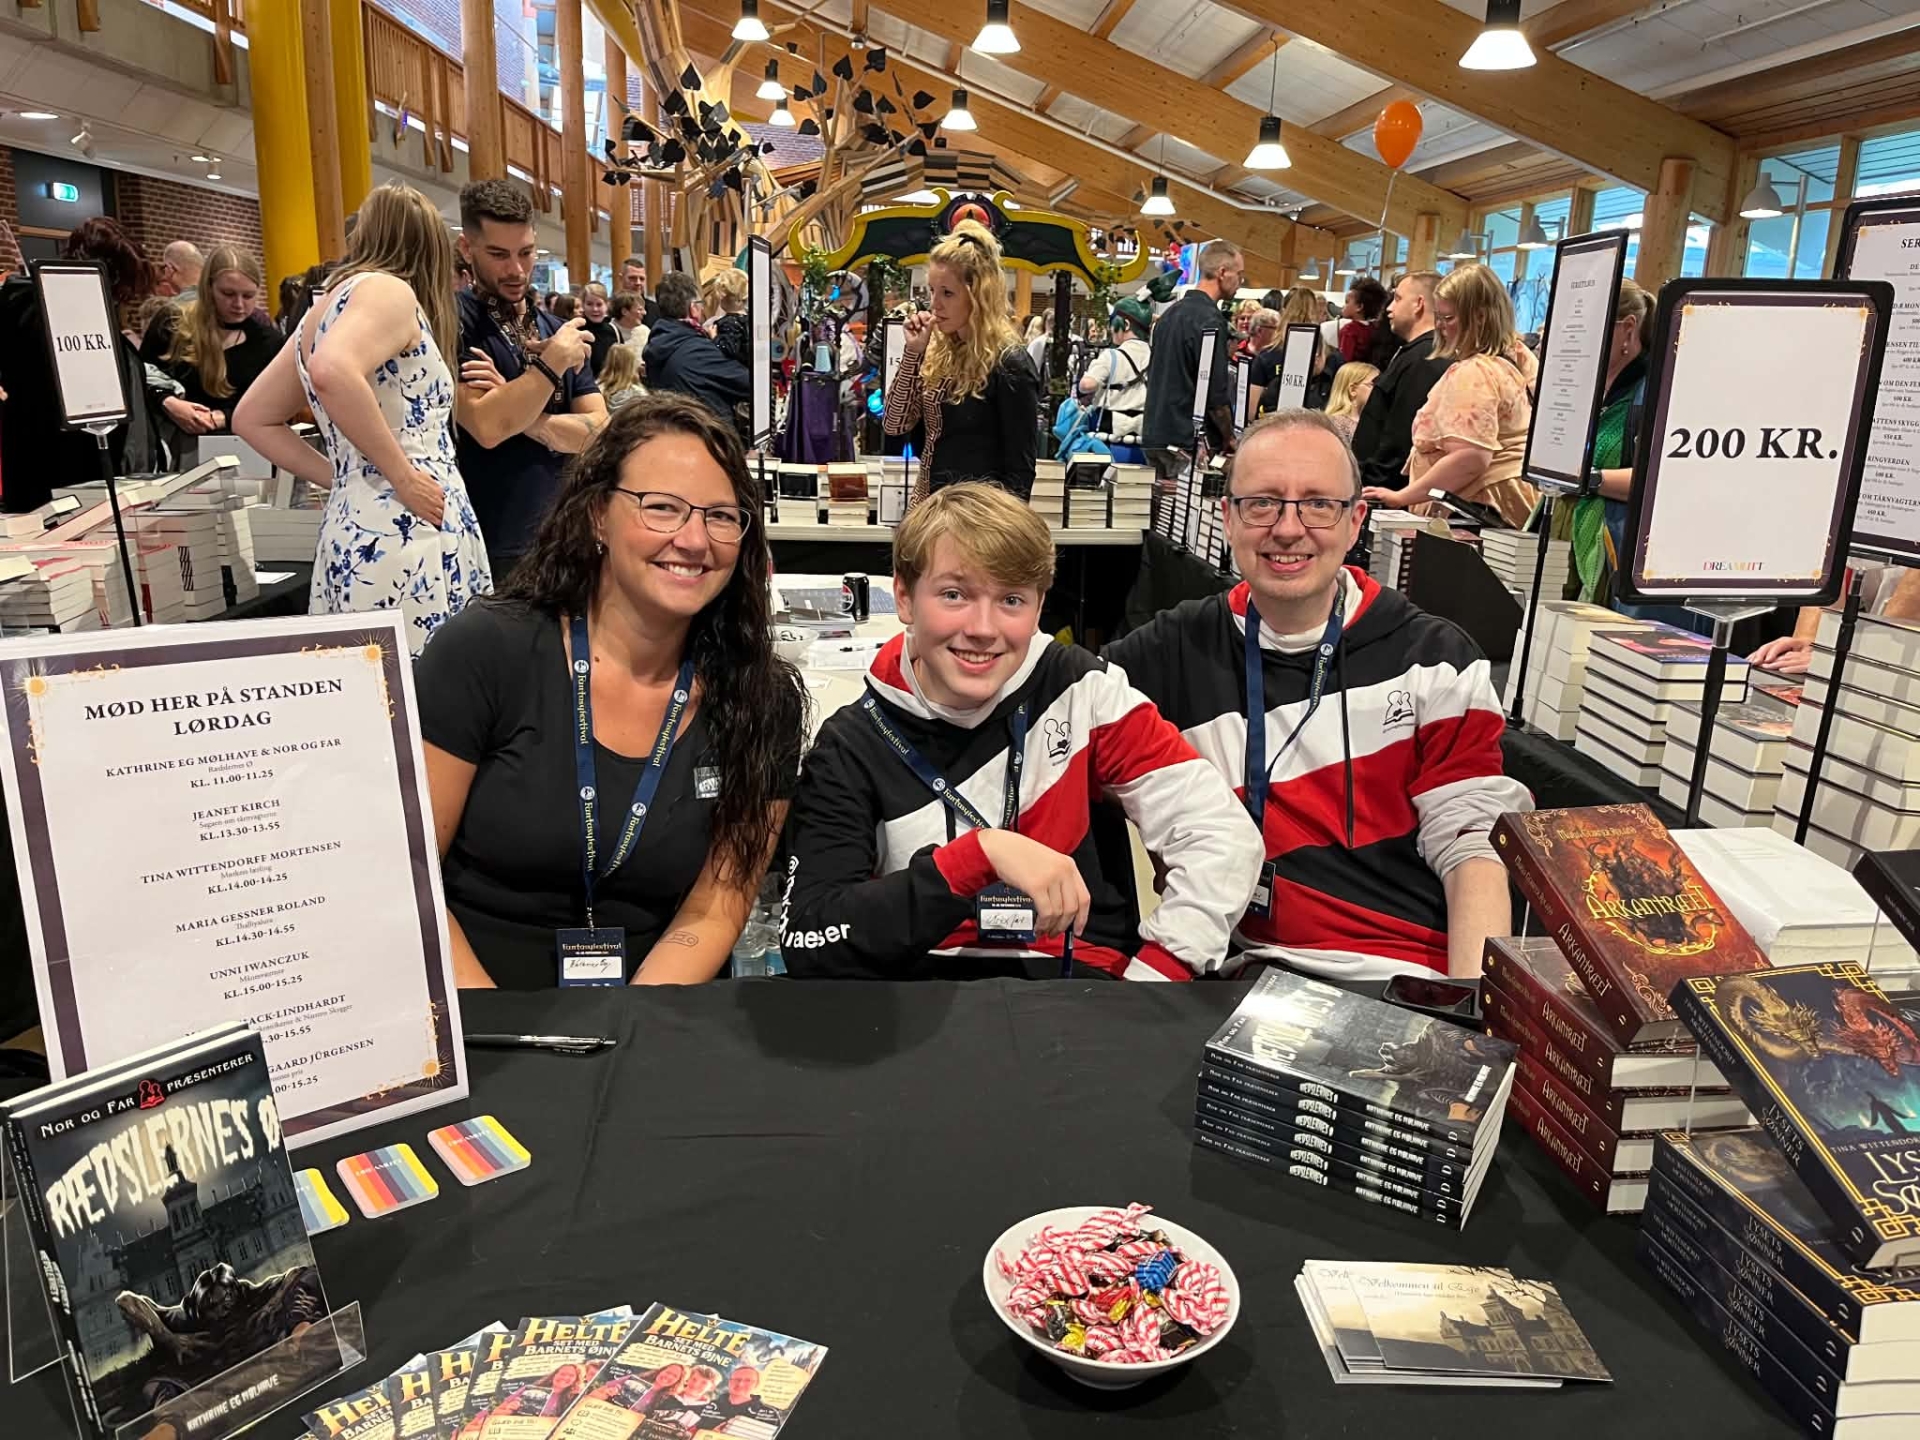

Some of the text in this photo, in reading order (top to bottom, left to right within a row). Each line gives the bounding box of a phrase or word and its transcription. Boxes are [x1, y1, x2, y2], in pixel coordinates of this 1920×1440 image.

[1901, 238, 1920, 248] SER
[56, 333, 112, 354] 100 KR.
[890, 357, 900, 366] 15
[1294, 374, 1305, 388] KR.
[1667, 428, 1838, 460] 200 KR.
[1874, 494, 1920, 507] TÅRNVAGTERN
[85, 679, 343, 720] MØD HER PÅ STANDEN
[174, 711, 272, 736] LØRDAG
[106, 738, 342, 777] KATHRINE EG MØLHAVE & NOR OG FAR
[190, 770, 274, 788] KL. 11.00-11.25
[192, 799, 280, 821] JEANET KIRCH
[943, 788, 986, 828] Fantasyfesti
[200, 821, 280, 842] KL.13.30-13.55
[611, 815, 640, 873] Fantasyfestiv
[141, 840, 342, 884] TINA WITTENDORFF MORTENSEN
[208, 872, 288, 895] KL.14.00-14.25
[980, 895, 1032, 903] Fantasyfestiva
[1585, 885, 1713, 920] ARKANTRÆET
[176, 918, 218, 932] MARIA
[220, 906, 274, 924] GESSNER
[277, 896, 326, 912] ROLAND
[216, 924, 296, 948] KL.14.30-14.55
[210, 951, 310, 980] UNNI IWANCZUK
[1558, 922, 1612, 998] ARKANTRÆET
[224, 974, 303, 1000] KL.15.00-15.25
[247, 995, 346, 1025] ACK-LINDHARDT
[263, 1024, 312, 1044] .30-15.55
[268, 1038, 374, 1074] GAARD JÜRGENSEN
[40, 1119, 74, 1139] NOR
[80, 1110, 100, 1123] OG
[107, 1097, 136, 1116] FAR
[166, 1053, 254, 1093] PRÆSENTERER
[275, 1076, 318, 1095] 00-15.25
[1769, 1104, 1805, 1152] LYSETS
[45, 1095, 281, 1238] RÆDSLERNES Ø
[1864, 1151, 1920, 1184] LYS
[518, 1318, 630, 1346] HELTE
[643, 1307, 751, 1358] HELTE
[692, 1340, 716, 1352] MED
[524, 1345, 586, 1356] BARNETS
[588, 1346, 618, 1356] ØJN
[644, 1334, 701, 1356] BARNETS
[701, 1349, 732, 1368] ØJNE
[229, 1394, 242, 1410] EG
[314, 1389, 391, 1438] HEL
[340, 1410, 393, 1440] BARNE
